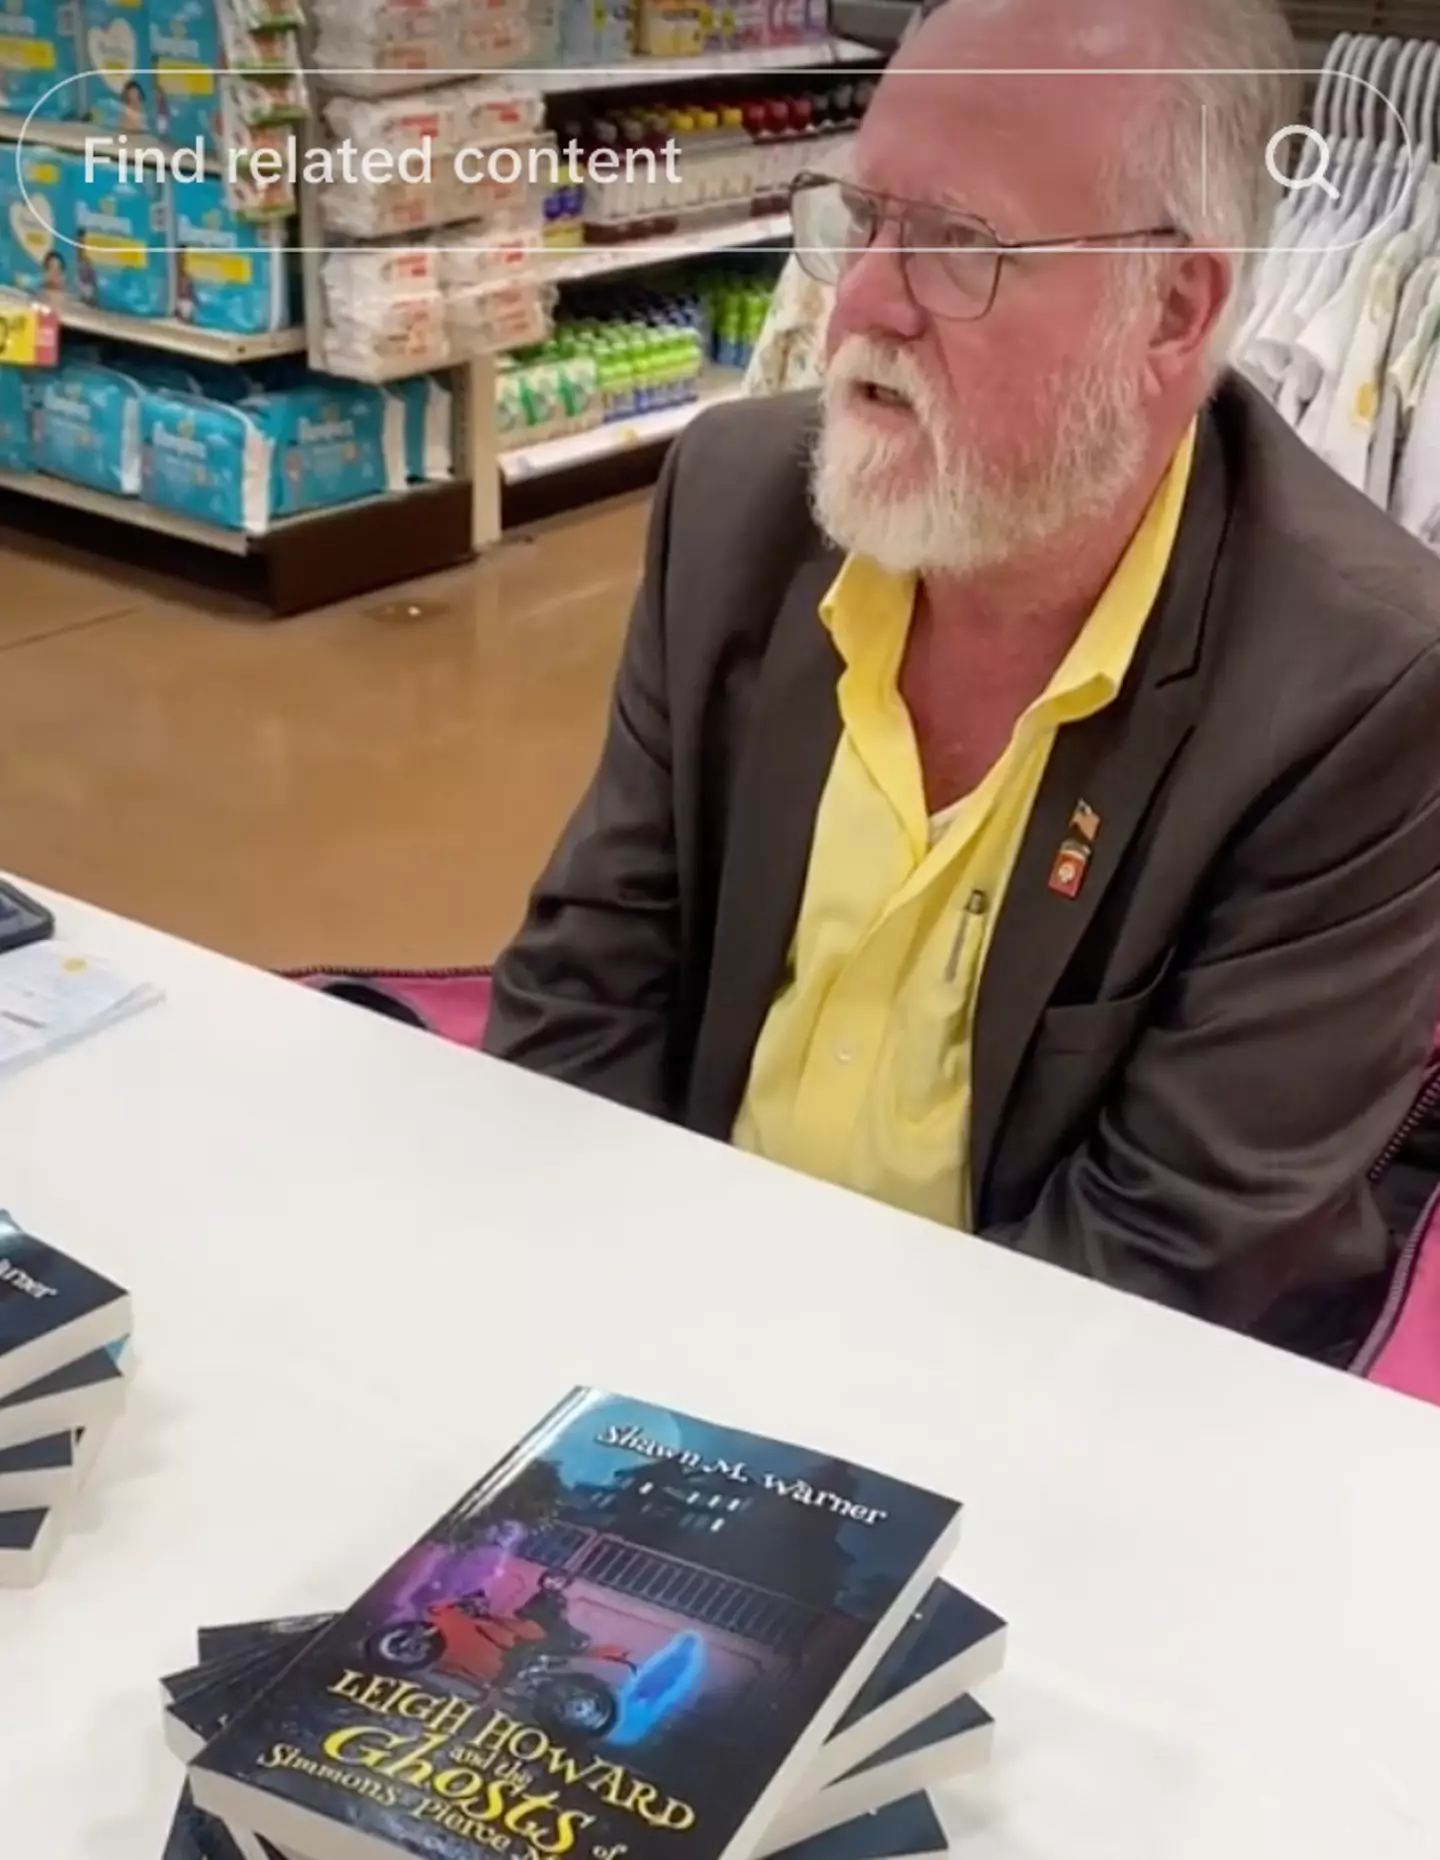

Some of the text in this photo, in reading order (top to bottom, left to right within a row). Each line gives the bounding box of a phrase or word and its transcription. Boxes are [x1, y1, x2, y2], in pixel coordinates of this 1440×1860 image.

[596, 1423, 703, 1468] Shawn
[322, 1725, 597, 1854] Ghosts
[327, 1667, 696, 1831] LEIGH HOWARD
[450, 1745, 500, 1770] and
